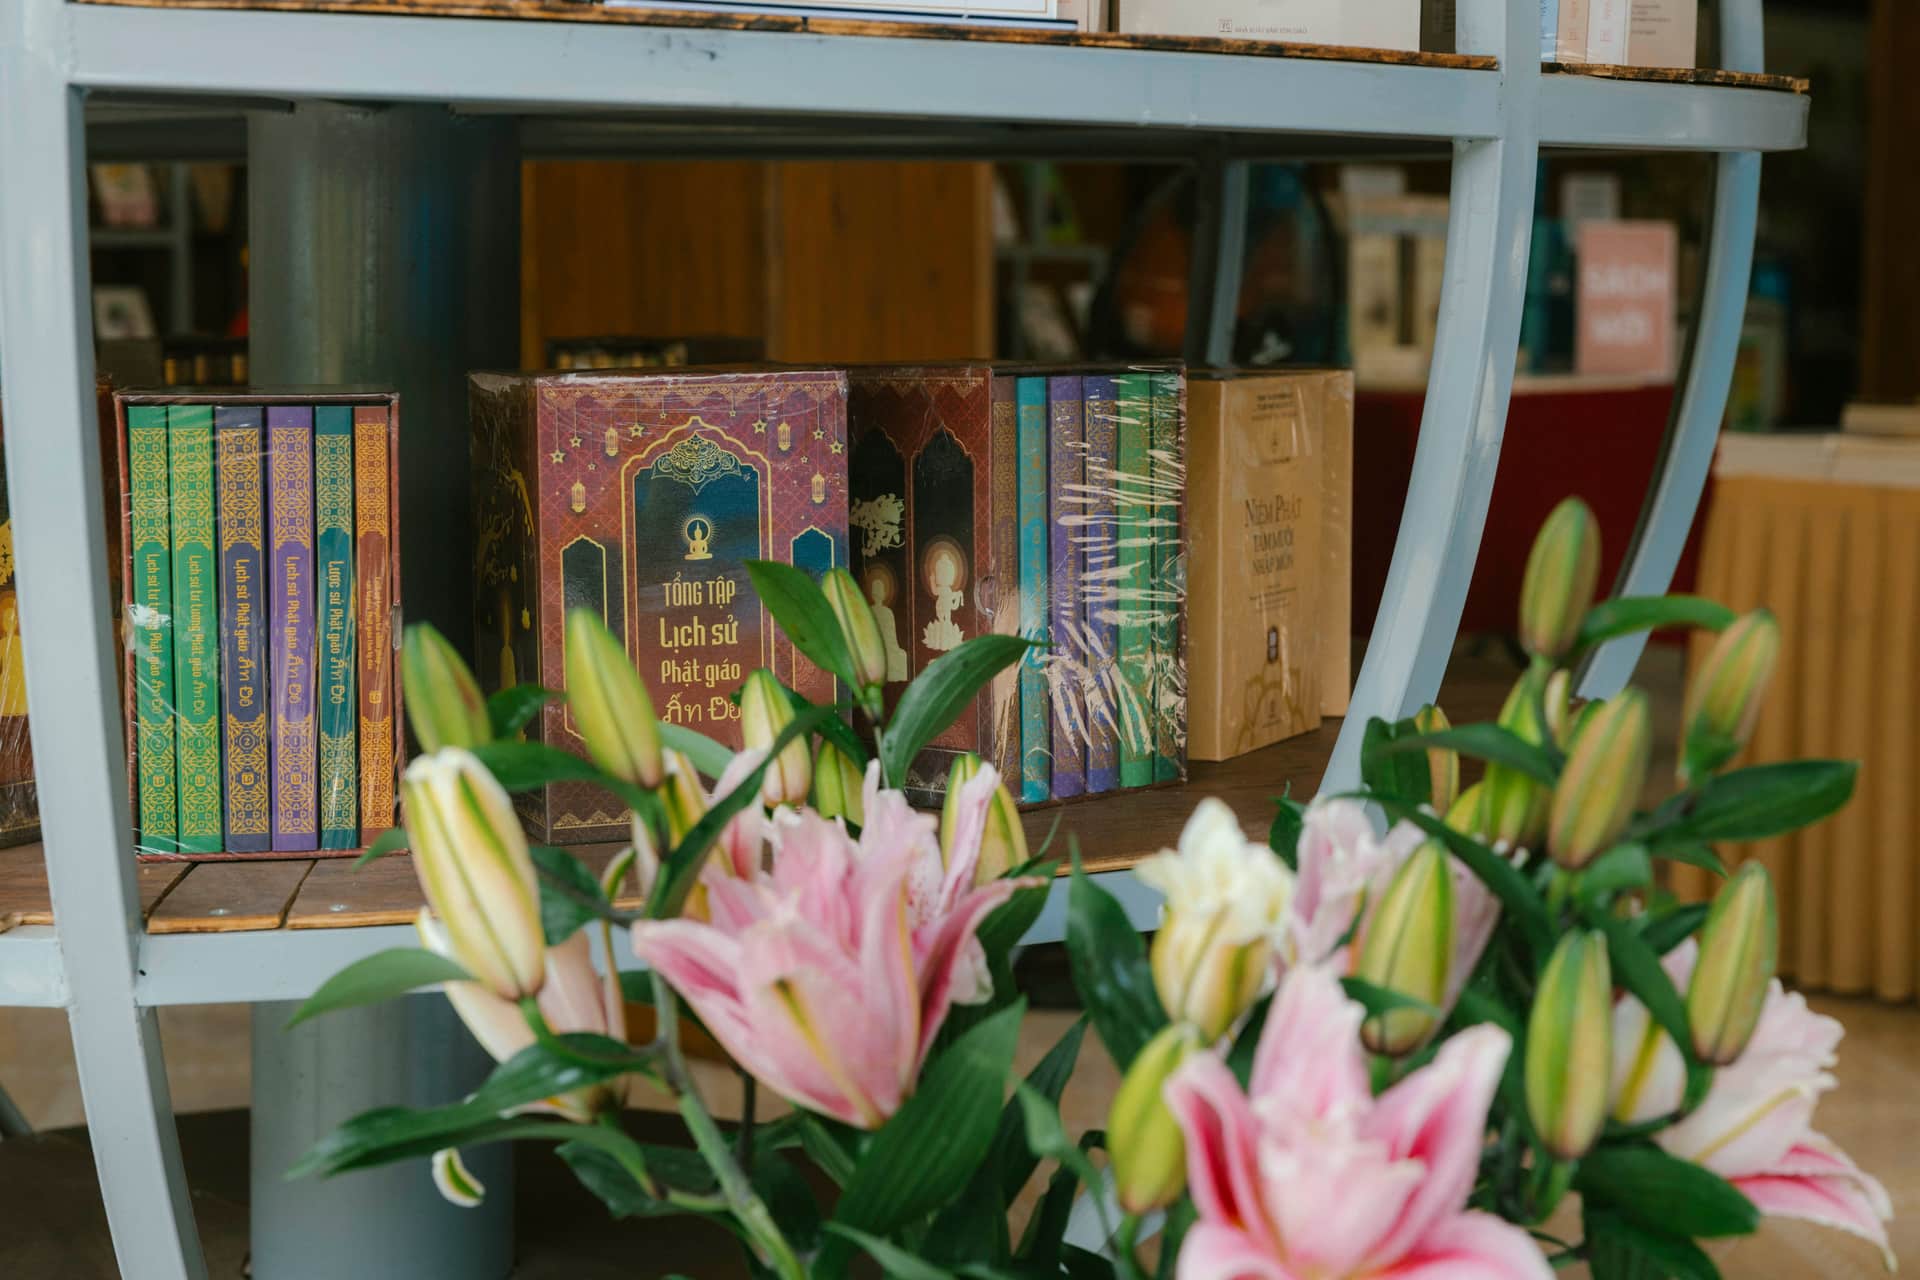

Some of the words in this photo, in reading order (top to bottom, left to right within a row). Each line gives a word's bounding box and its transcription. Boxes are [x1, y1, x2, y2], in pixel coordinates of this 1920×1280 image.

[233, 559, 251, 582] Lịch
[283, 556, 302, 581] Lịch
[236, 585, 254, 598] sử
[287, 583, 304, 597] sử
[662, 571, 702, 607] TỔNG
[706, 575, 736, 609] TẬP
[236, 602, 252, 627] Phật
[286, 600, 303, 623] Phật
[329, 608, 346, 632] Phật
[233, 630, 252, 651] giáo
[659, 615, 706, 654] Lịch
[711, 614, 739, 646] sử
[238, 656, 258, 681] Ấn
[661, 658, 702, 687] Phật
[705, 658, 741, 688] giáo
[662, 691, 702, 723] Ấn
